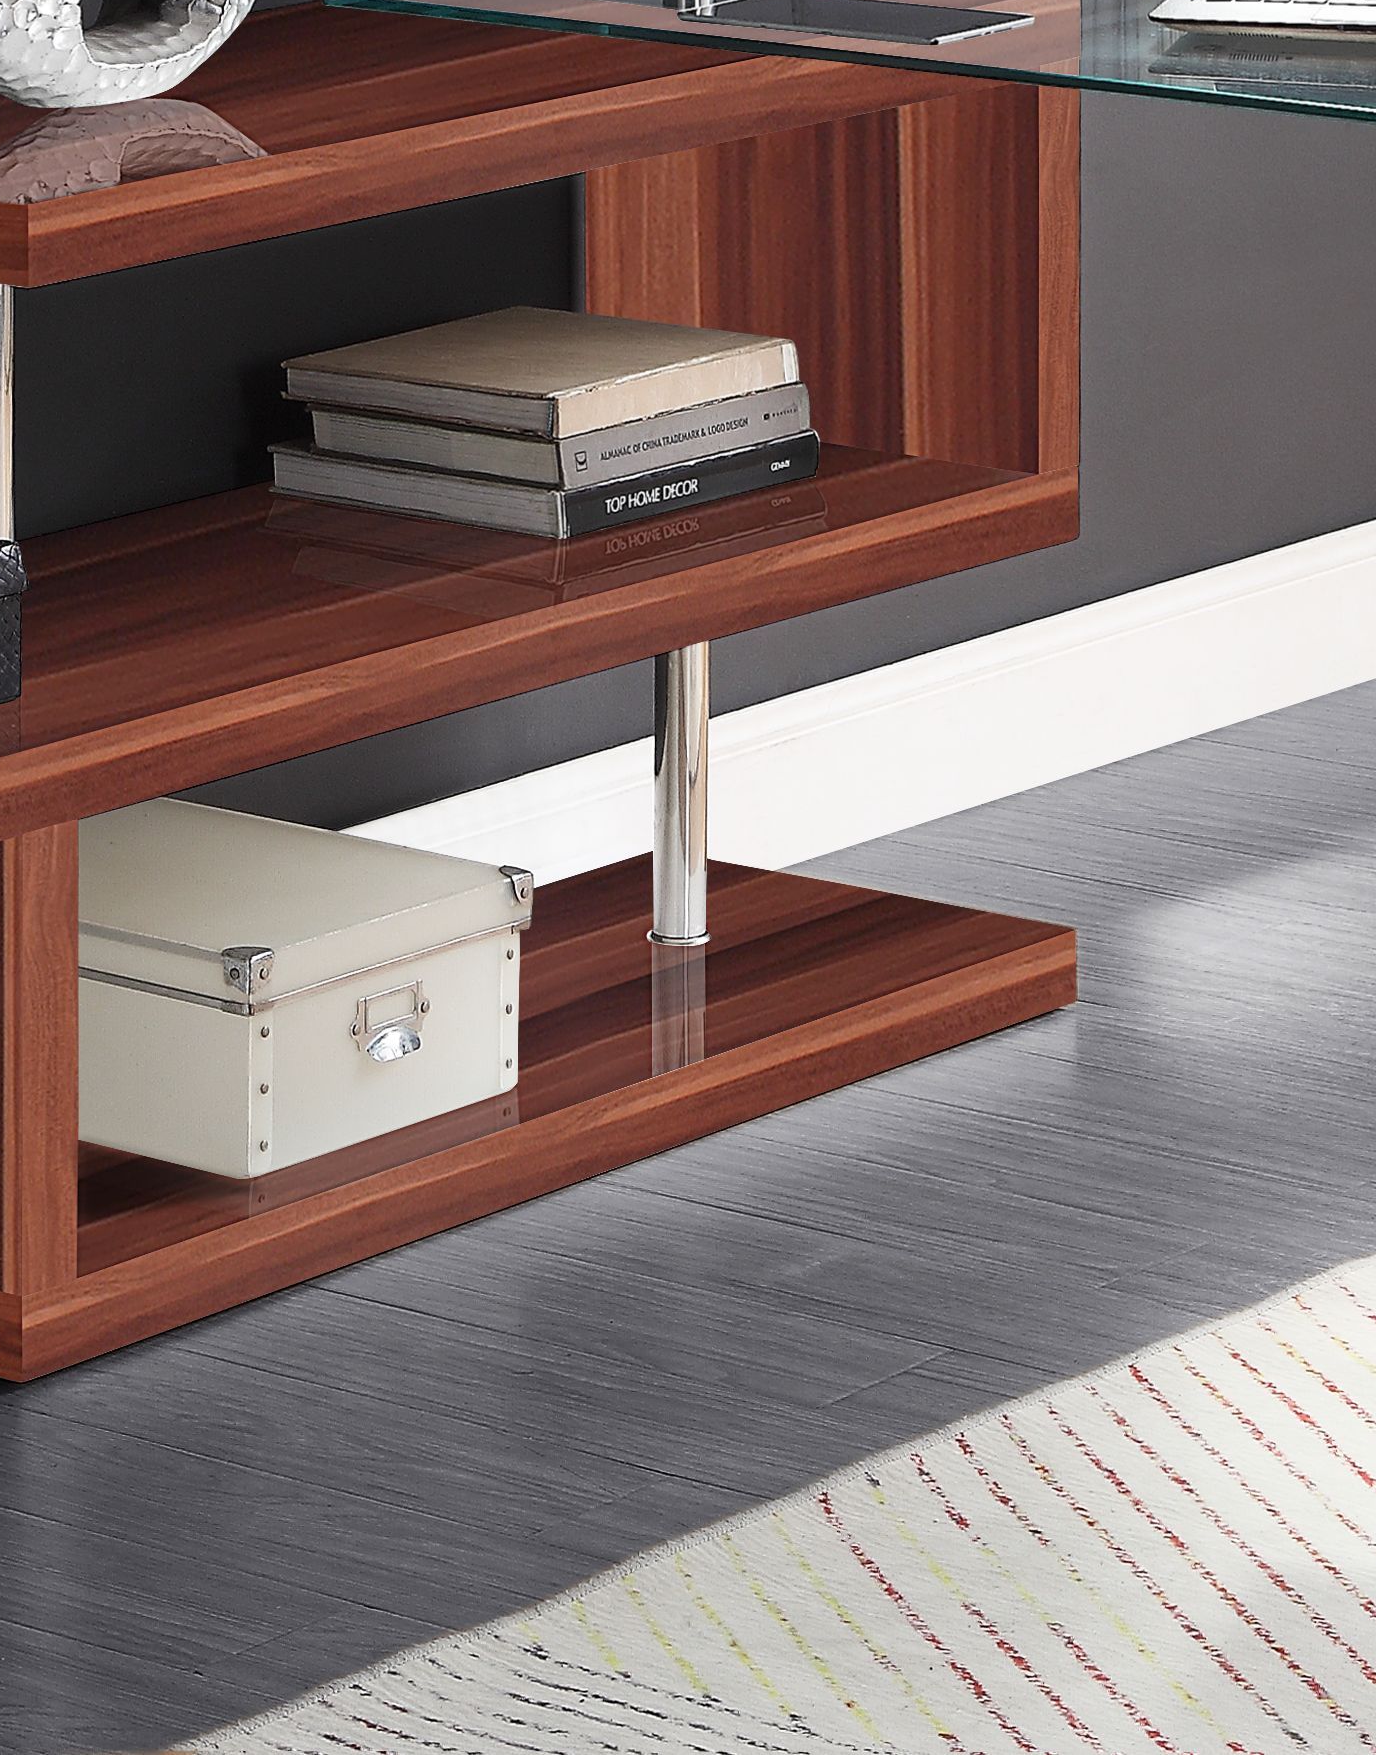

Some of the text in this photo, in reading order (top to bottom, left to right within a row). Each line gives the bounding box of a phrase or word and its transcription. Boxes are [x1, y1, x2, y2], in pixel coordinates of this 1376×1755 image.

[662, 429, 701, 446] TRADEMARK
[700, 428, 707, 438] &
[707, 423, 726, 436] LOGO
[725, 417, 749, 432] DESIGN
[604, 478, 699, 514] TOP HOME DECOR
